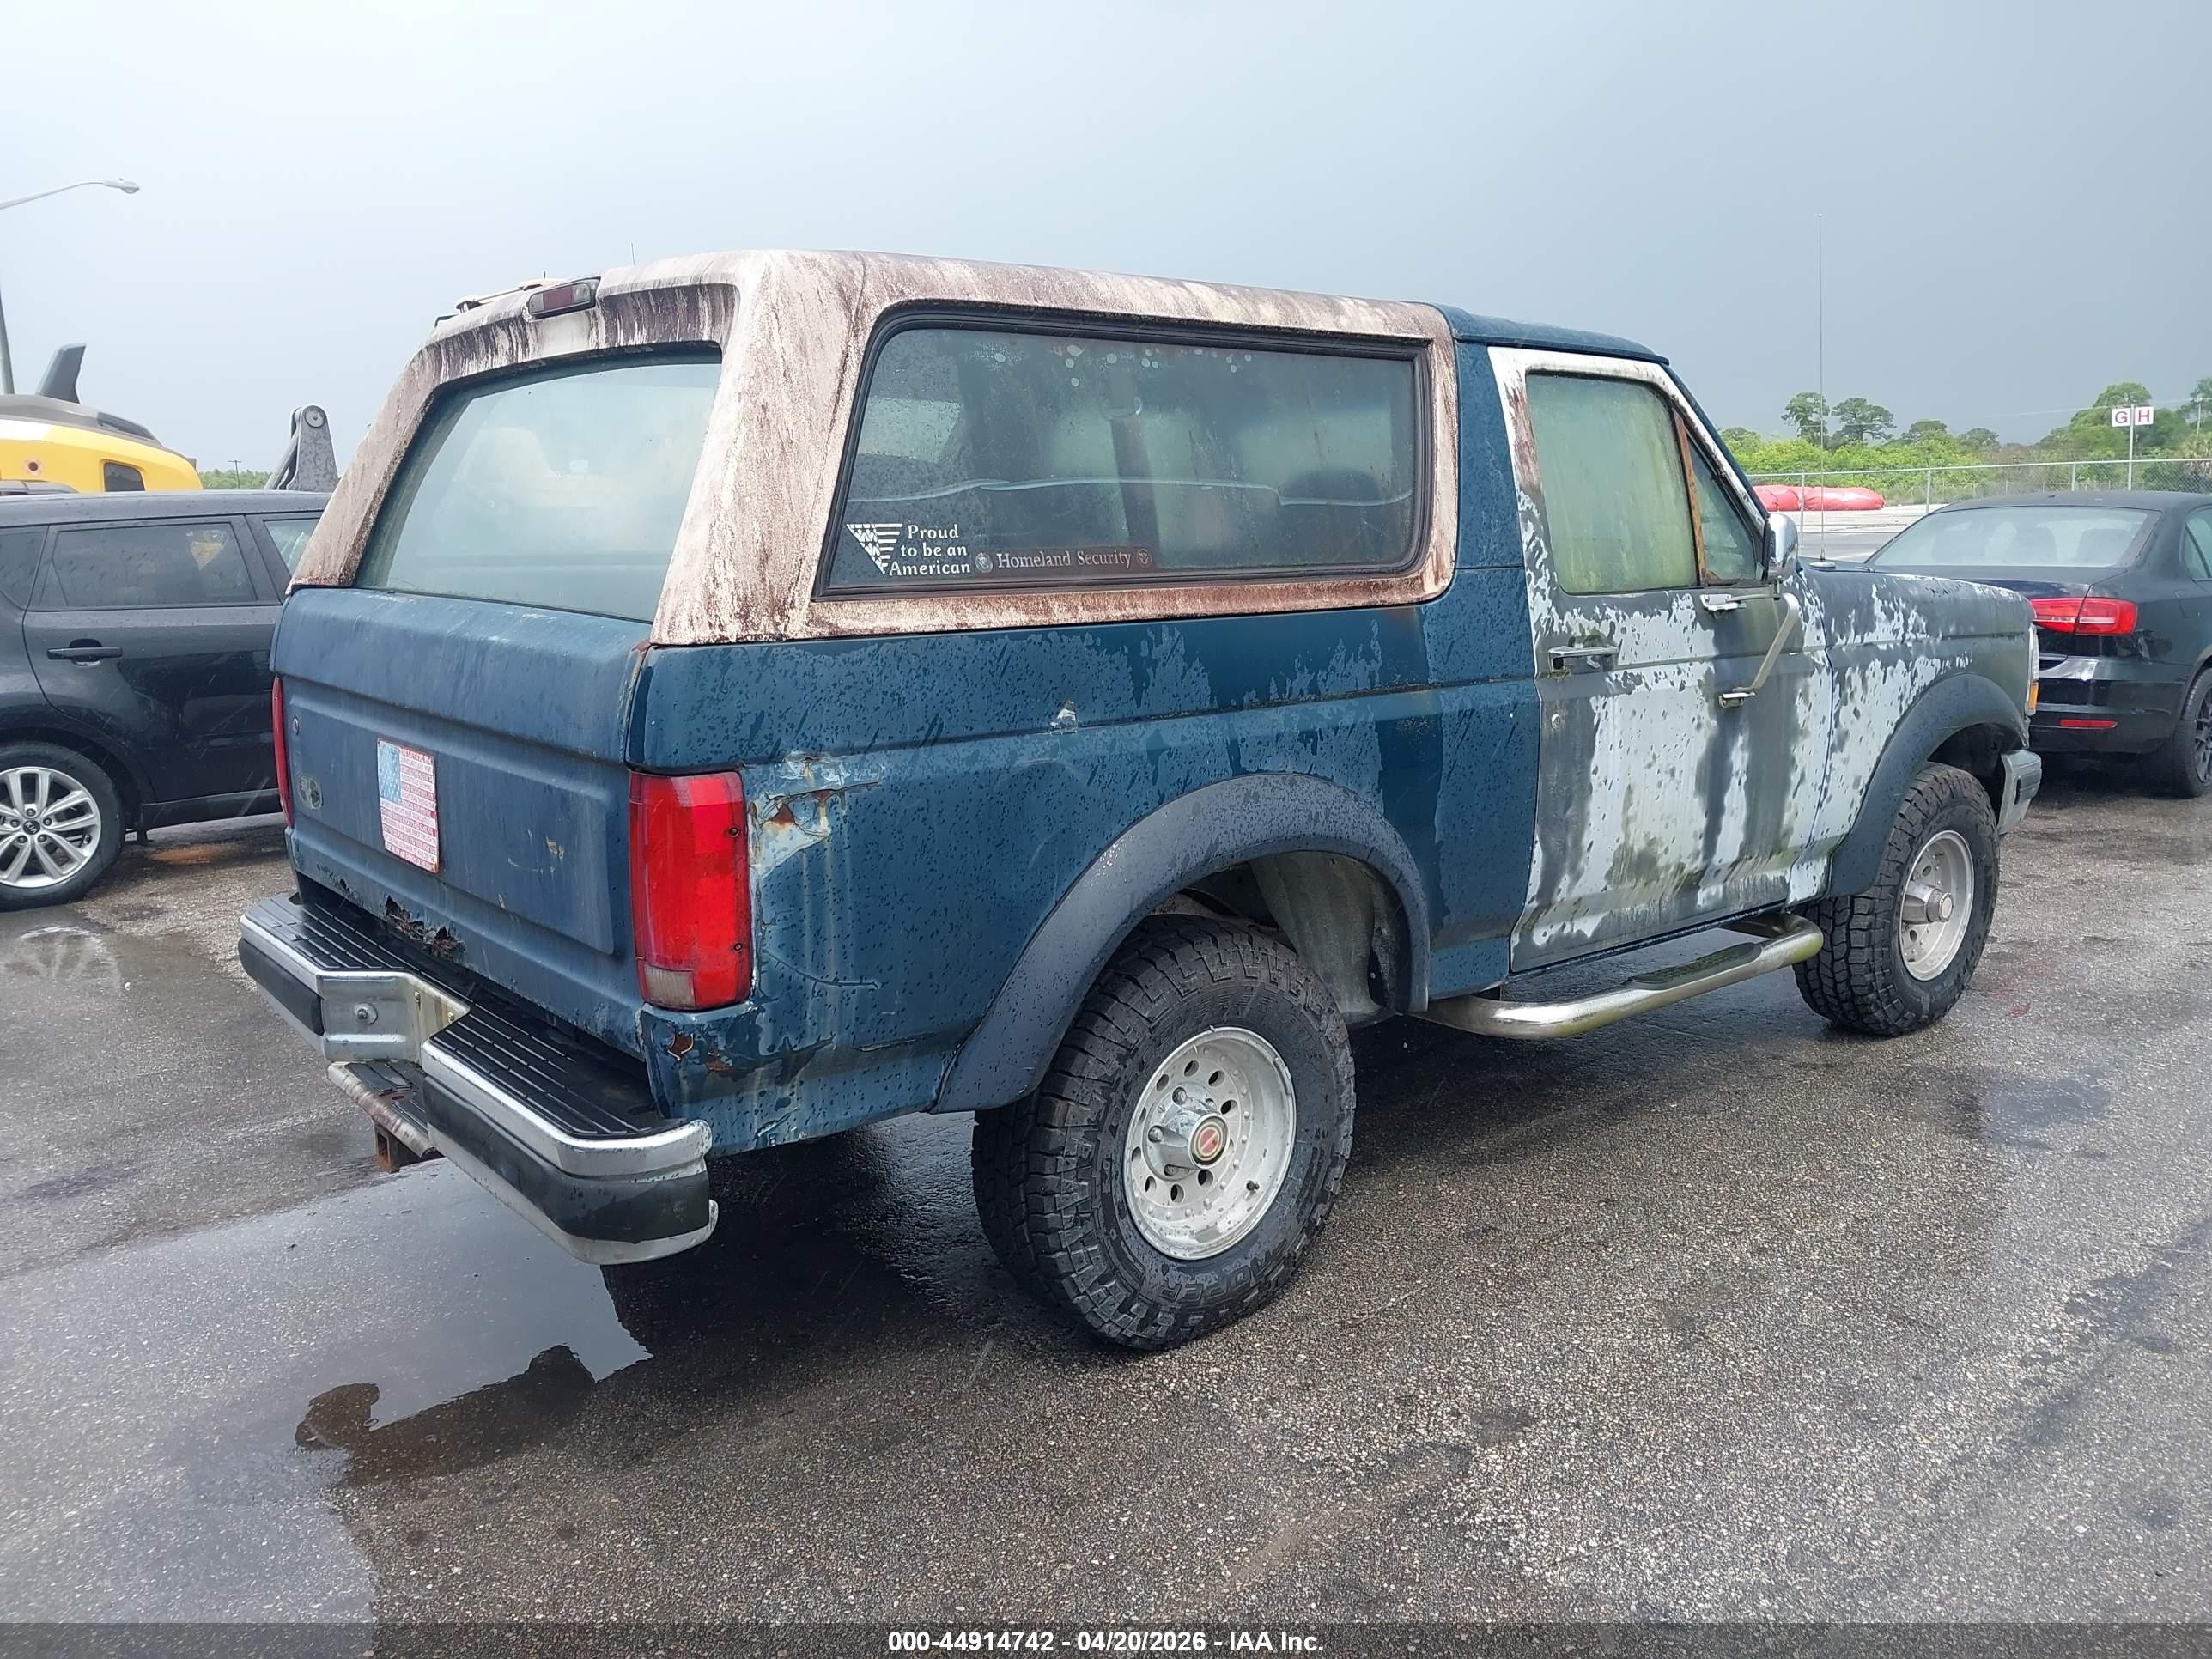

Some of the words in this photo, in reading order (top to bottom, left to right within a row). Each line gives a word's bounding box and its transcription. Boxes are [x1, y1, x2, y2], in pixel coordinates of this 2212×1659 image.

[2115, 410, 2128, 424] G
[2138, 409, 2150, 422] H
[908, 524, 959, 539] Proud
[901, 544, 917, 557] to
[922, 542, 942, 557] be
[946, 545, 968, 556] an
[996, 550, 1071, 568] Homeland
[1077, 550, 1131, 569] Security
[889, 560, 971, 576] American
